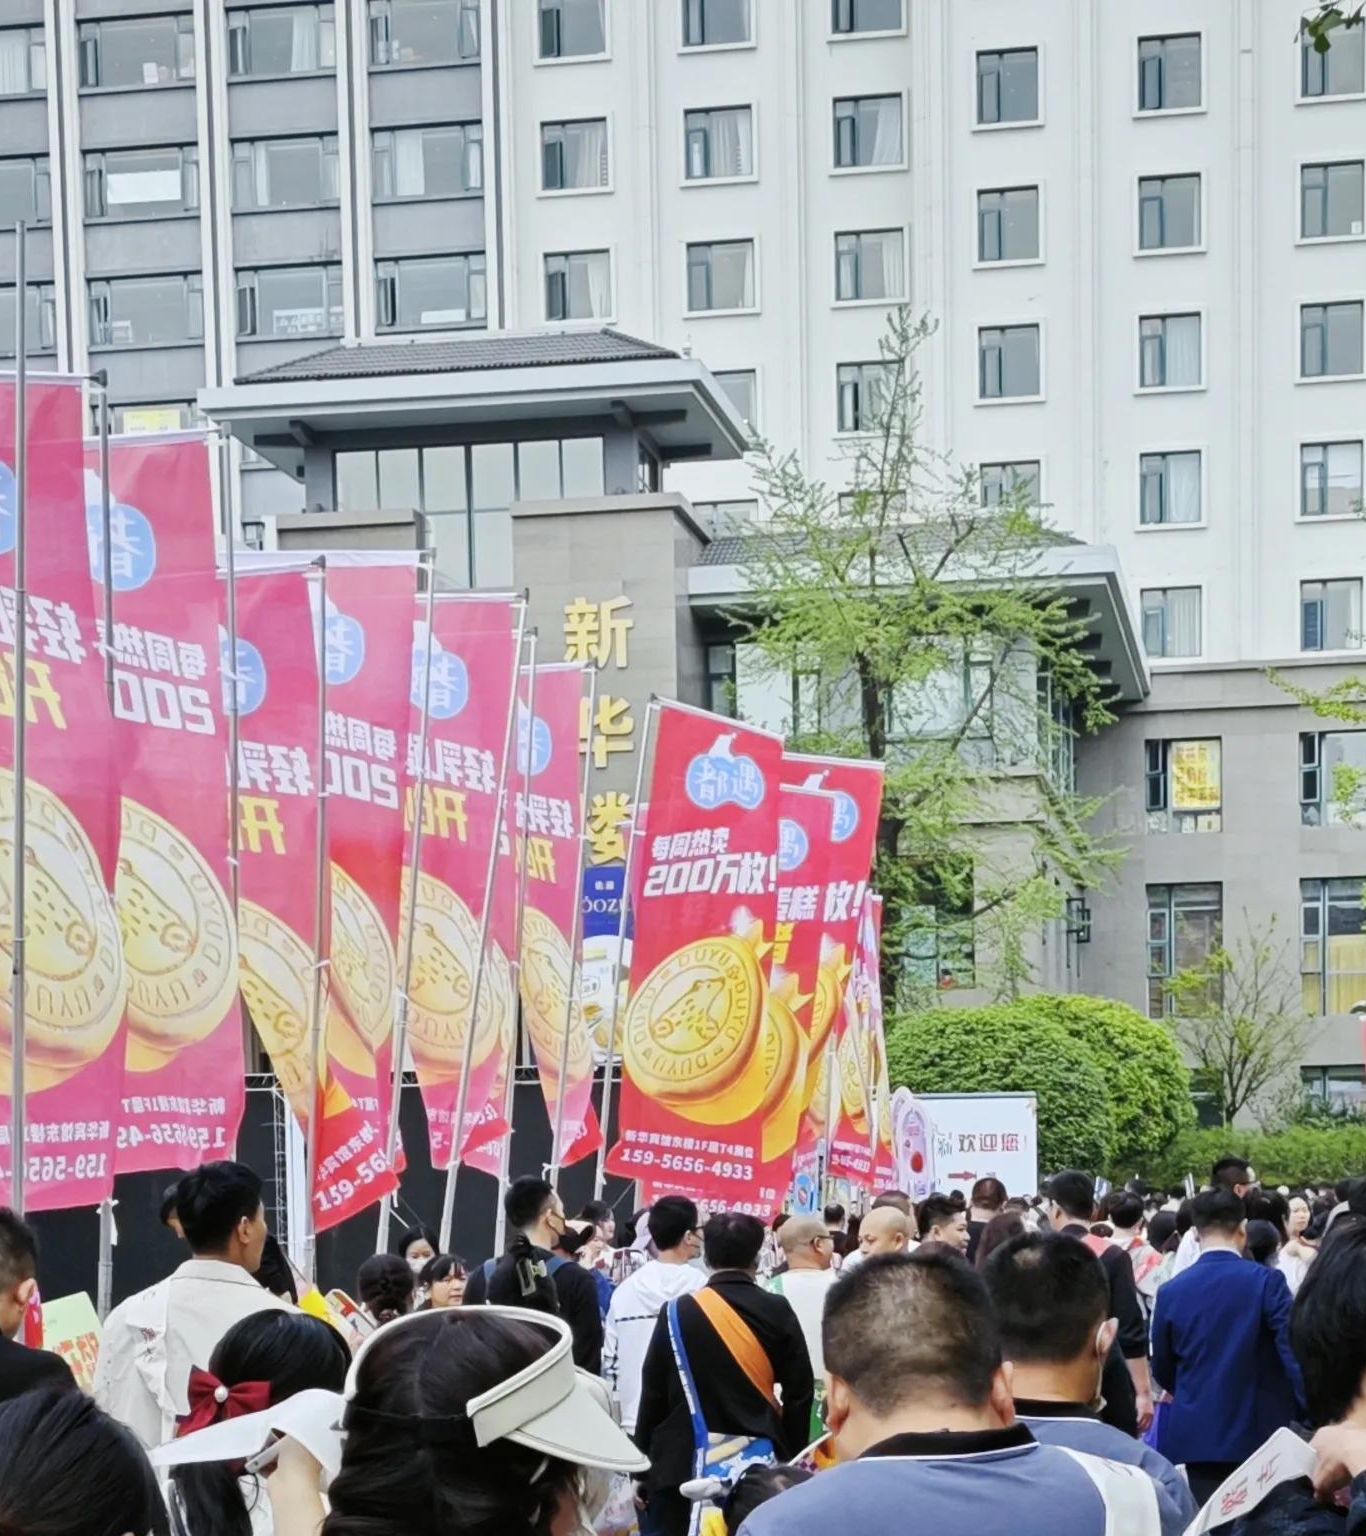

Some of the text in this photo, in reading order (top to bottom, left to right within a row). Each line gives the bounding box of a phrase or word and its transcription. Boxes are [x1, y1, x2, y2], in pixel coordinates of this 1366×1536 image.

[693, 760, 760, 802] 都遇
[651, 827, 731, 863] 每周热卖
[643, 850, 779, 897] 200万枚!
[618, 1146, 755, 1183] 159-5656-4933
